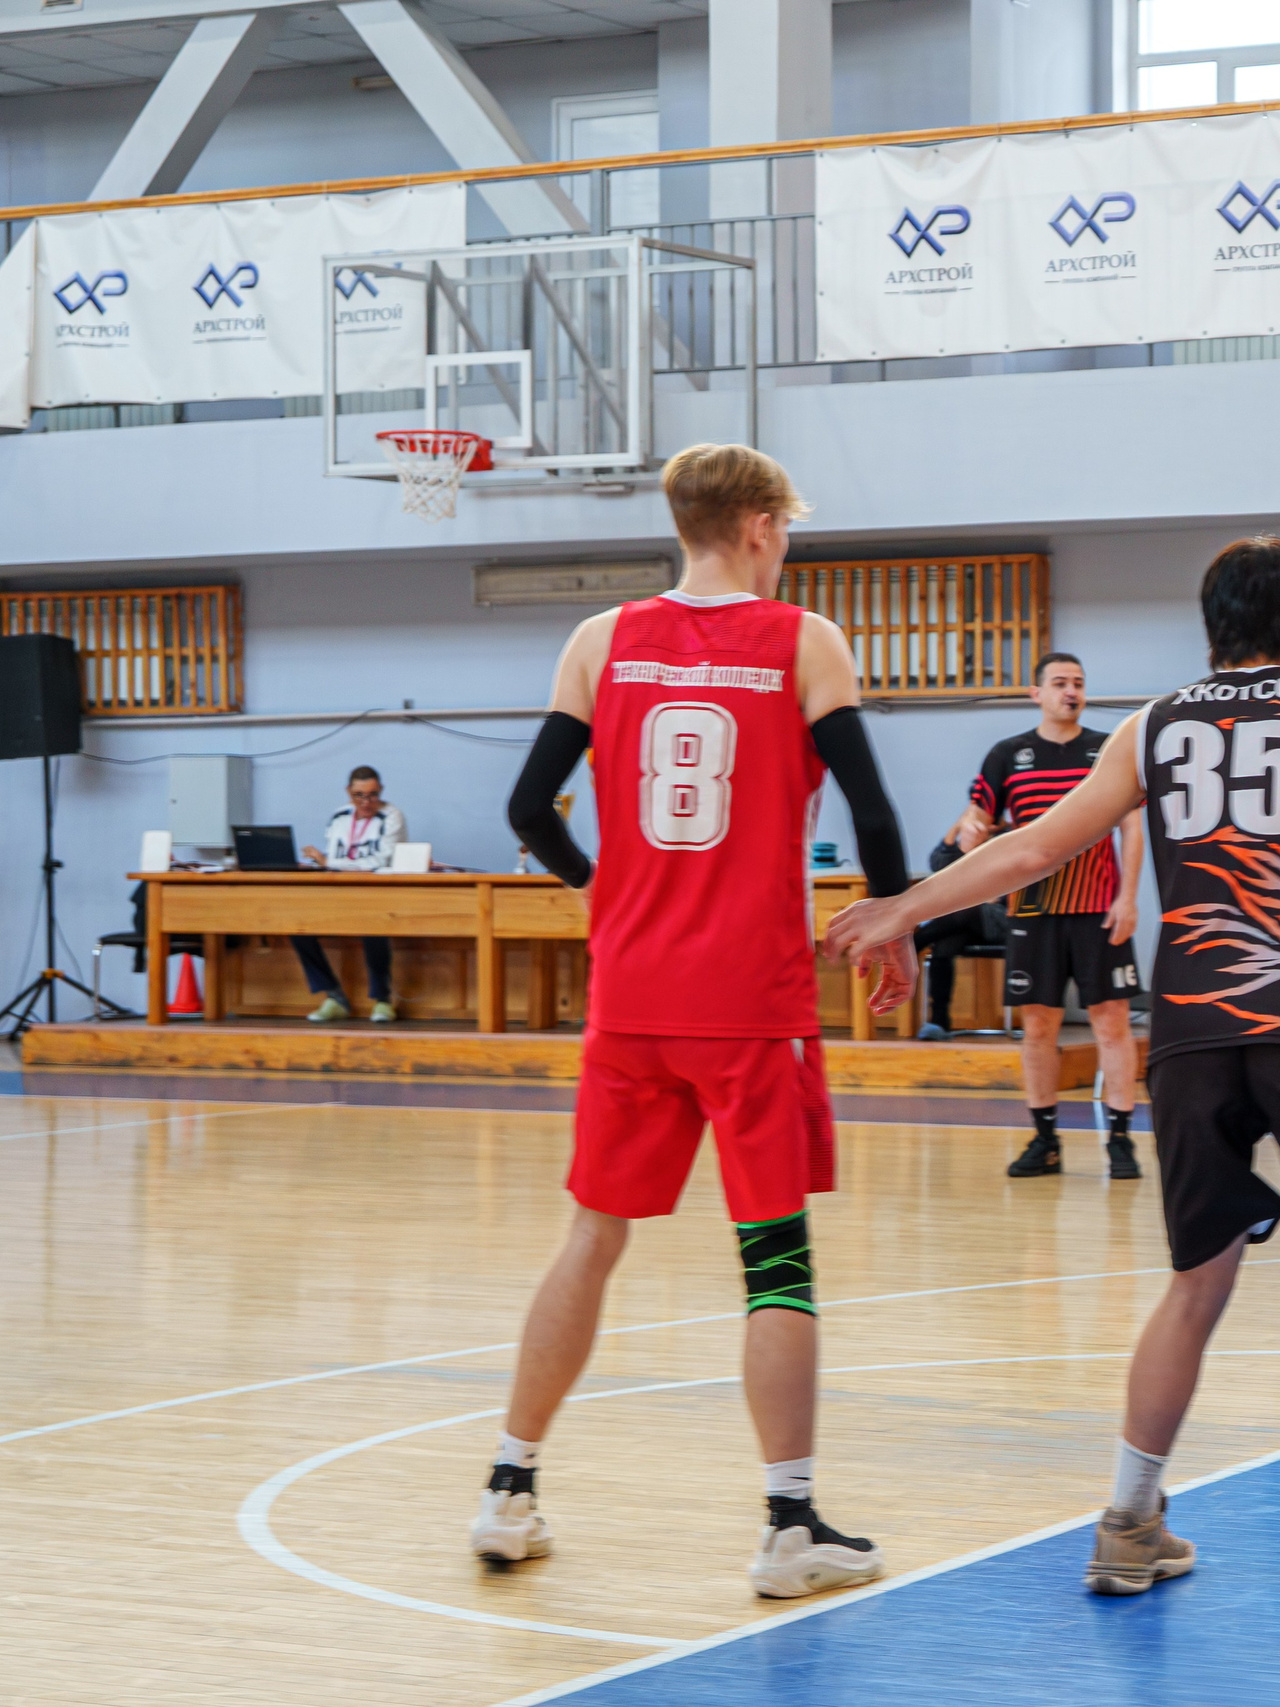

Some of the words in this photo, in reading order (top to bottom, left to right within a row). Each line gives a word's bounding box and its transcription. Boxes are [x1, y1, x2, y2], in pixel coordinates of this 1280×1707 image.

[1045, 250, 1136, 272] АРХСТРОЙ
[885, 262, 973, 284] АРХСТРОЙ
[193, 314, 266, 334] АРХСТРОЙ
[639, 701, 738, 851] 8
